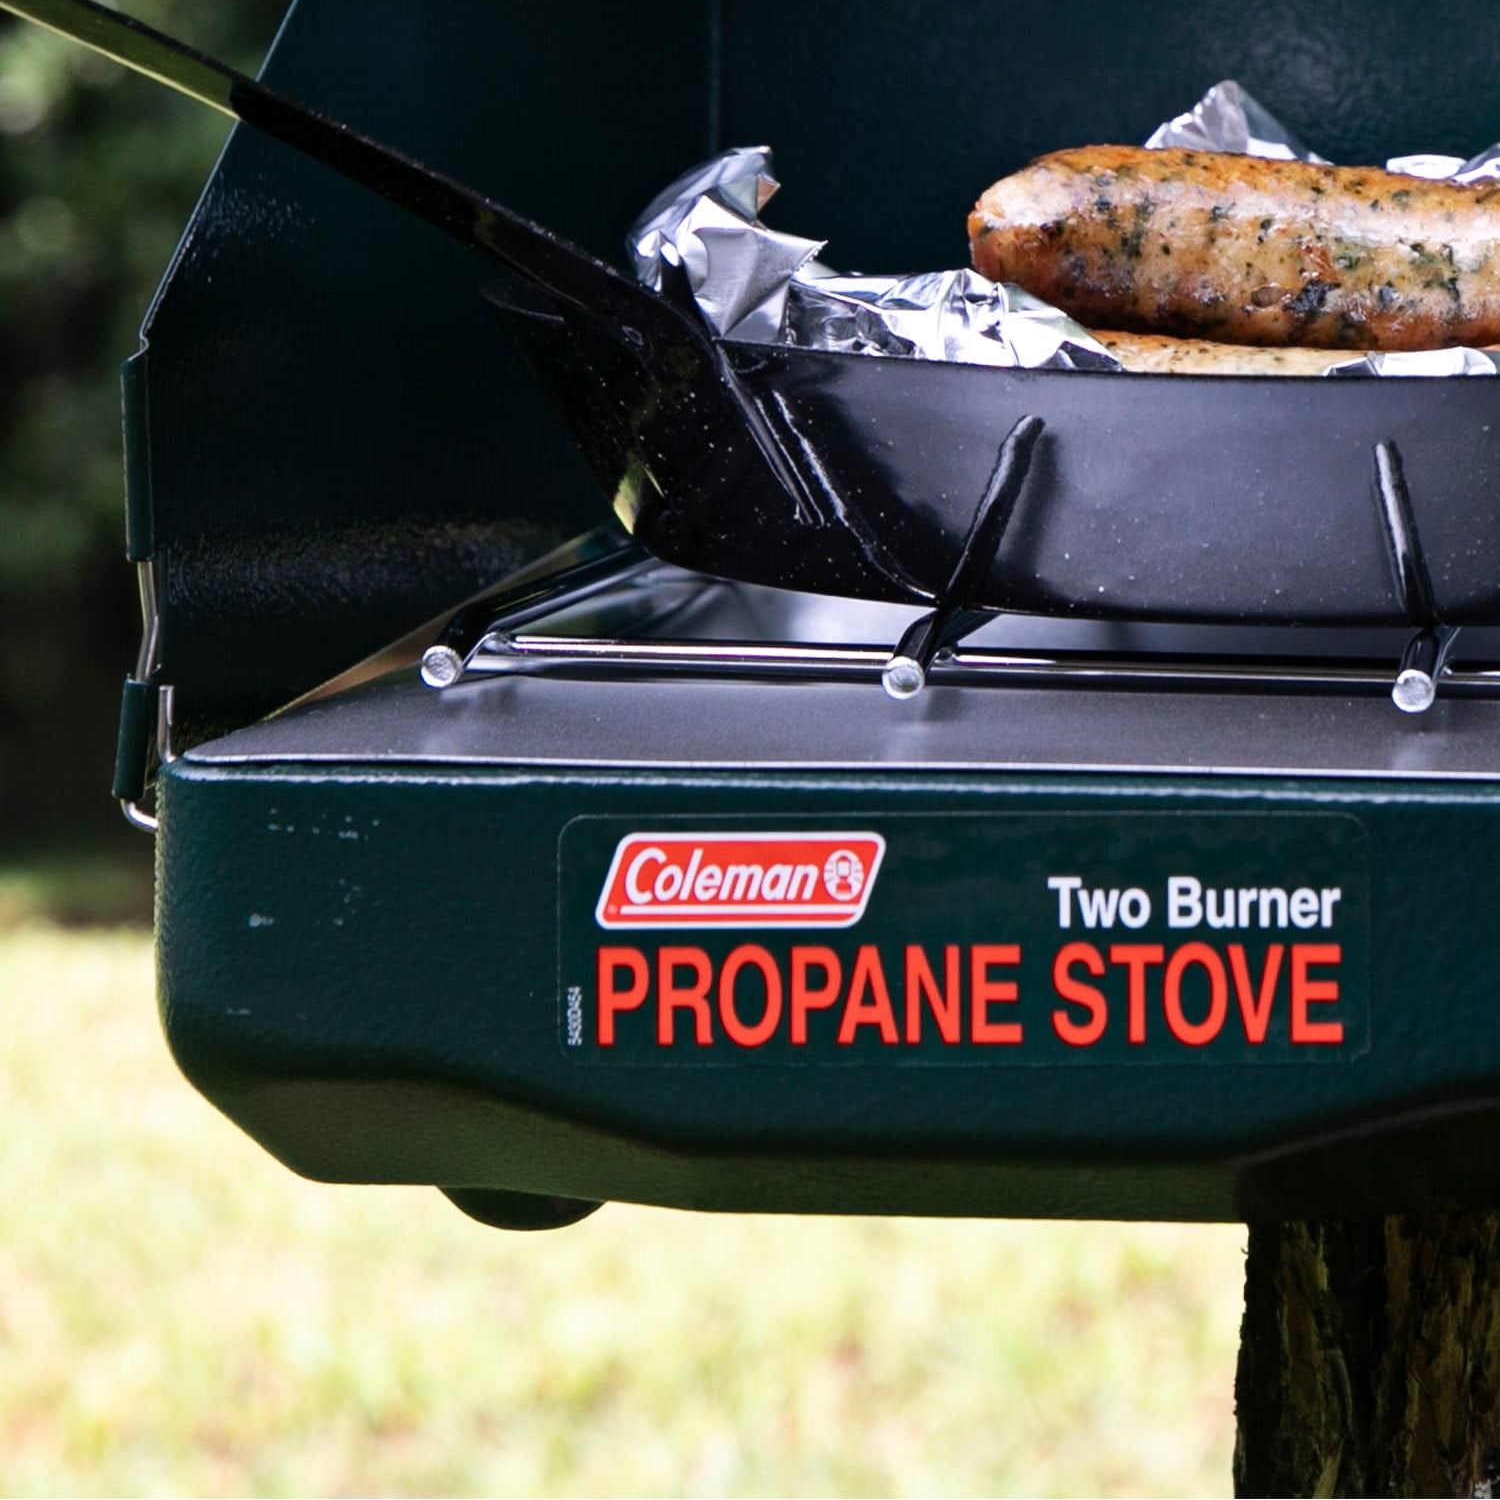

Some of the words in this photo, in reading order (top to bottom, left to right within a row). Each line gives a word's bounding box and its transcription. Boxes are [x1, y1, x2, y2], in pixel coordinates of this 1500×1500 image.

[624, 846, 817, 904] Coleman
[1048, 876, 1151, 929] Two
[1167, 876, 1342, 929] Burner
[598, 944, 1024, 1047] PROPANE
[1052, 942, 1345, 1048] STOVE
